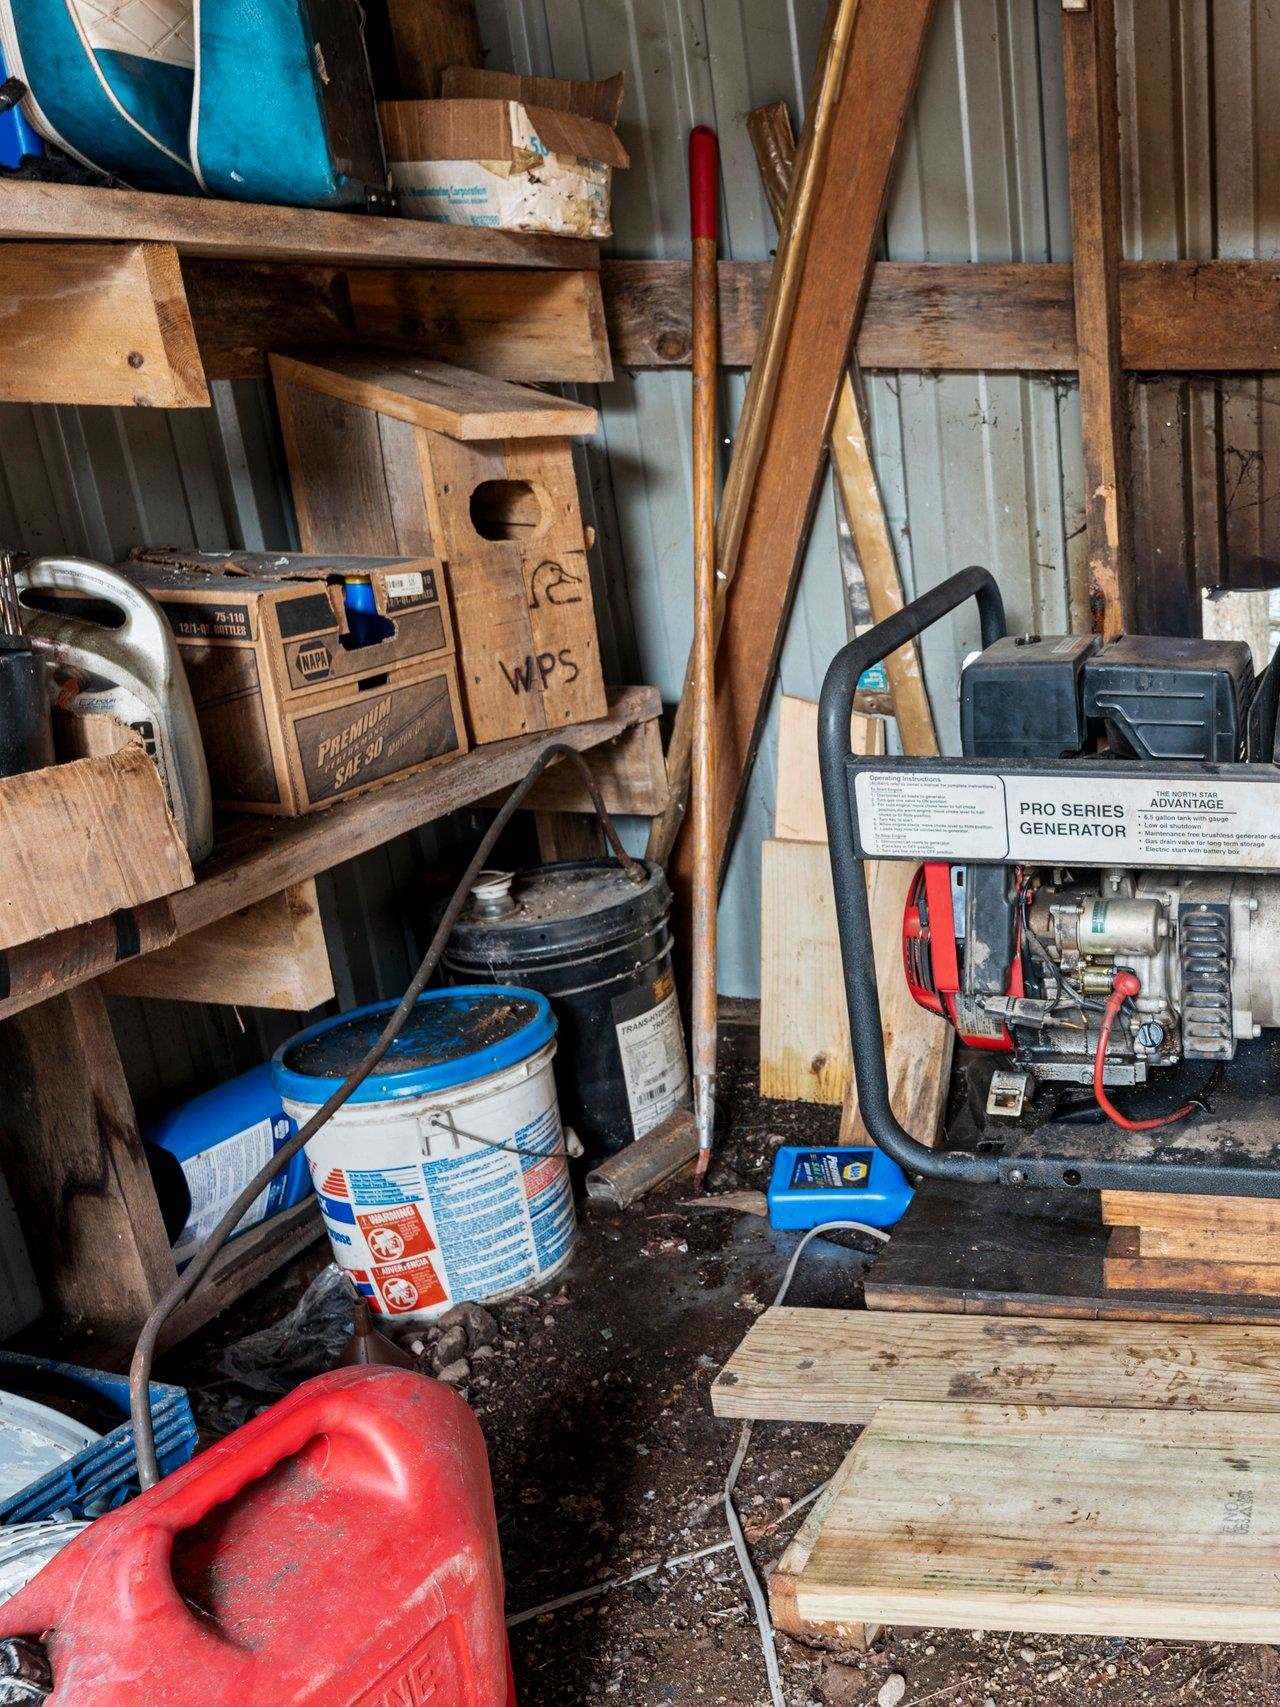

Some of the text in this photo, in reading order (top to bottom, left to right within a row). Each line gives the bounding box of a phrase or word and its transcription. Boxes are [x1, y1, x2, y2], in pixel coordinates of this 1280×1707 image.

[215, 611, 245, 624] 75-110
[213, 624, 247, 636] BOTTLES
[301, 650, 328, 672] NAPA
[498, 649, 580, 695] WPS
[317, 694, 393, 768] PREMIUM
[334, 735, 385, 790] SAE 30
[869, 774, 900, 782] Operating
[1156, 790, 1170, 798] THE
[1172, 791, 1197, 799] NORTH
[1020, 802, 1125, 819] PRO SERIES
[1150, 798, 1224, 810] ADVANTAGE
[1020, 821, 1127, 838] GENERATOR
[1144, 830, 1186, 838] Maintenance
[1240, 841, 1266, 849] storage
[368, 1205, 416, 1226] WARNING
